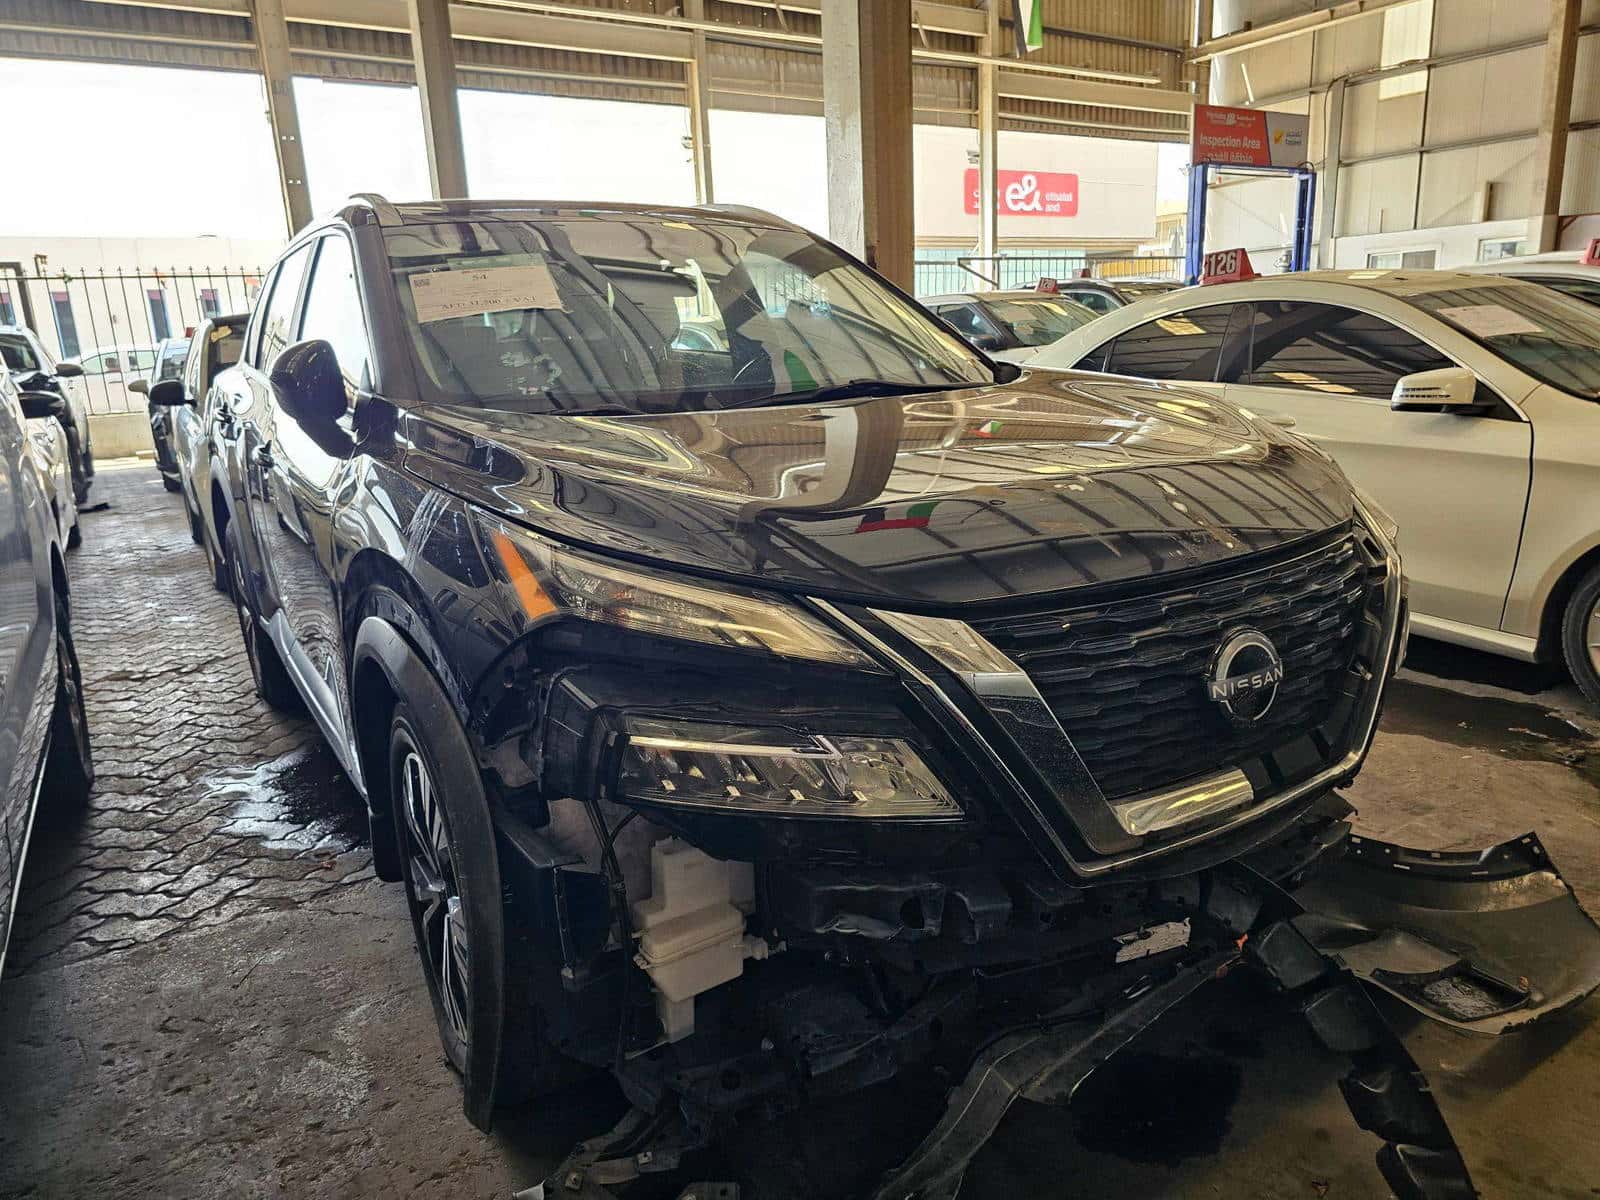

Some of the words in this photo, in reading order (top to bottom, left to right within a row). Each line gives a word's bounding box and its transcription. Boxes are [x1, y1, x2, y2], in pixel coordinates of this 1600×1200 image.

[1200, 132, 1241, 149] Inspection
[1242, 136, 1260, 150] Area
[1210, 252, 1236, 276] 126
[1212, 667, 1283, 699] NISSAN
